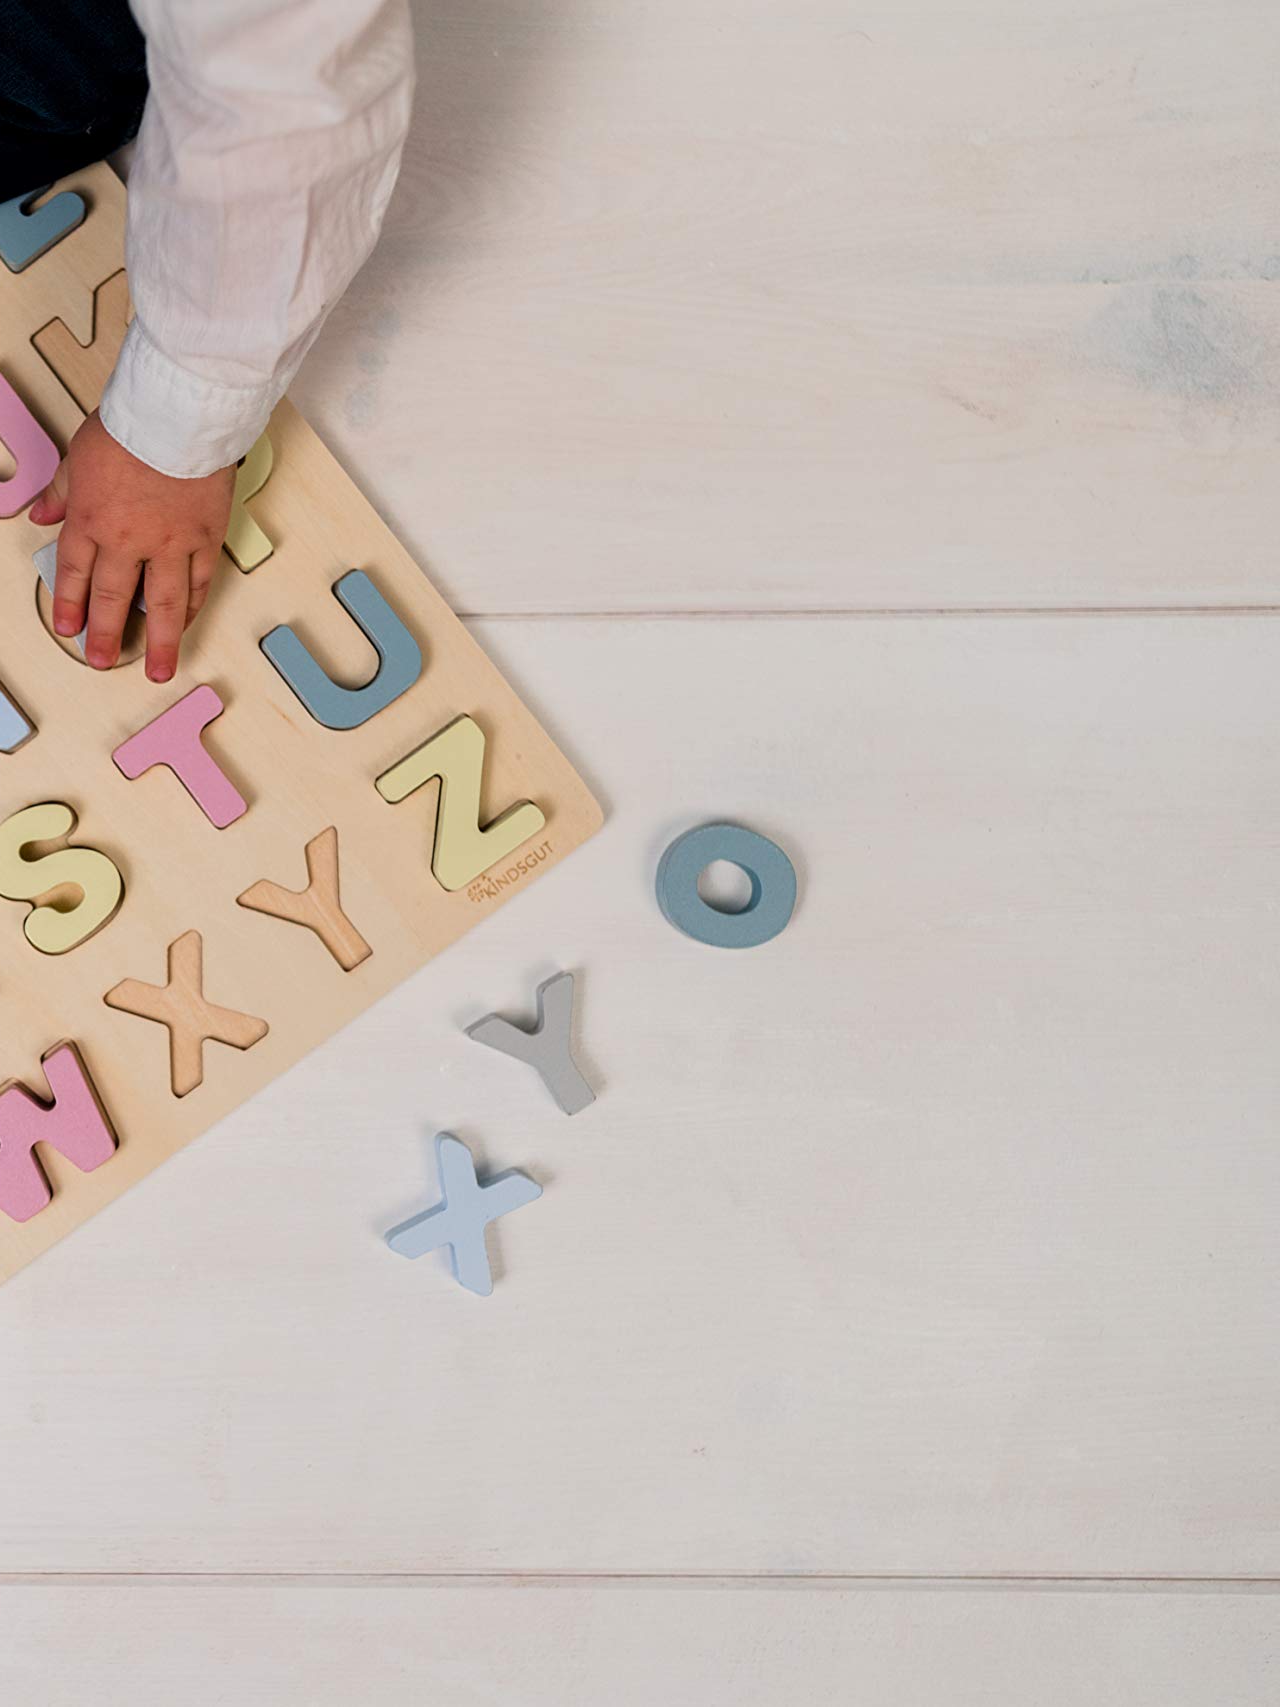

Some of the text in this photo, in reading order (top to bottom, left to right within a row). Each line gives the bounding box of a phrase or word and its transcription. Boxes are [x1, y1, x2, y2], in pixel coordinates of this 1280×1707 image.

[112, 684, 249, 829] T
[258, 569, 421, 730] U
[103, 929, 269, 1099] X
[236, 826, 373, 972] Y
[374, 712, 546, 892] Z
[482, 840, 554, 899] KINDSGUT
[655, 821, 798, 949] O
[462, 971, 598, 1116] Y
[384, 1131, 543, 1298] X
